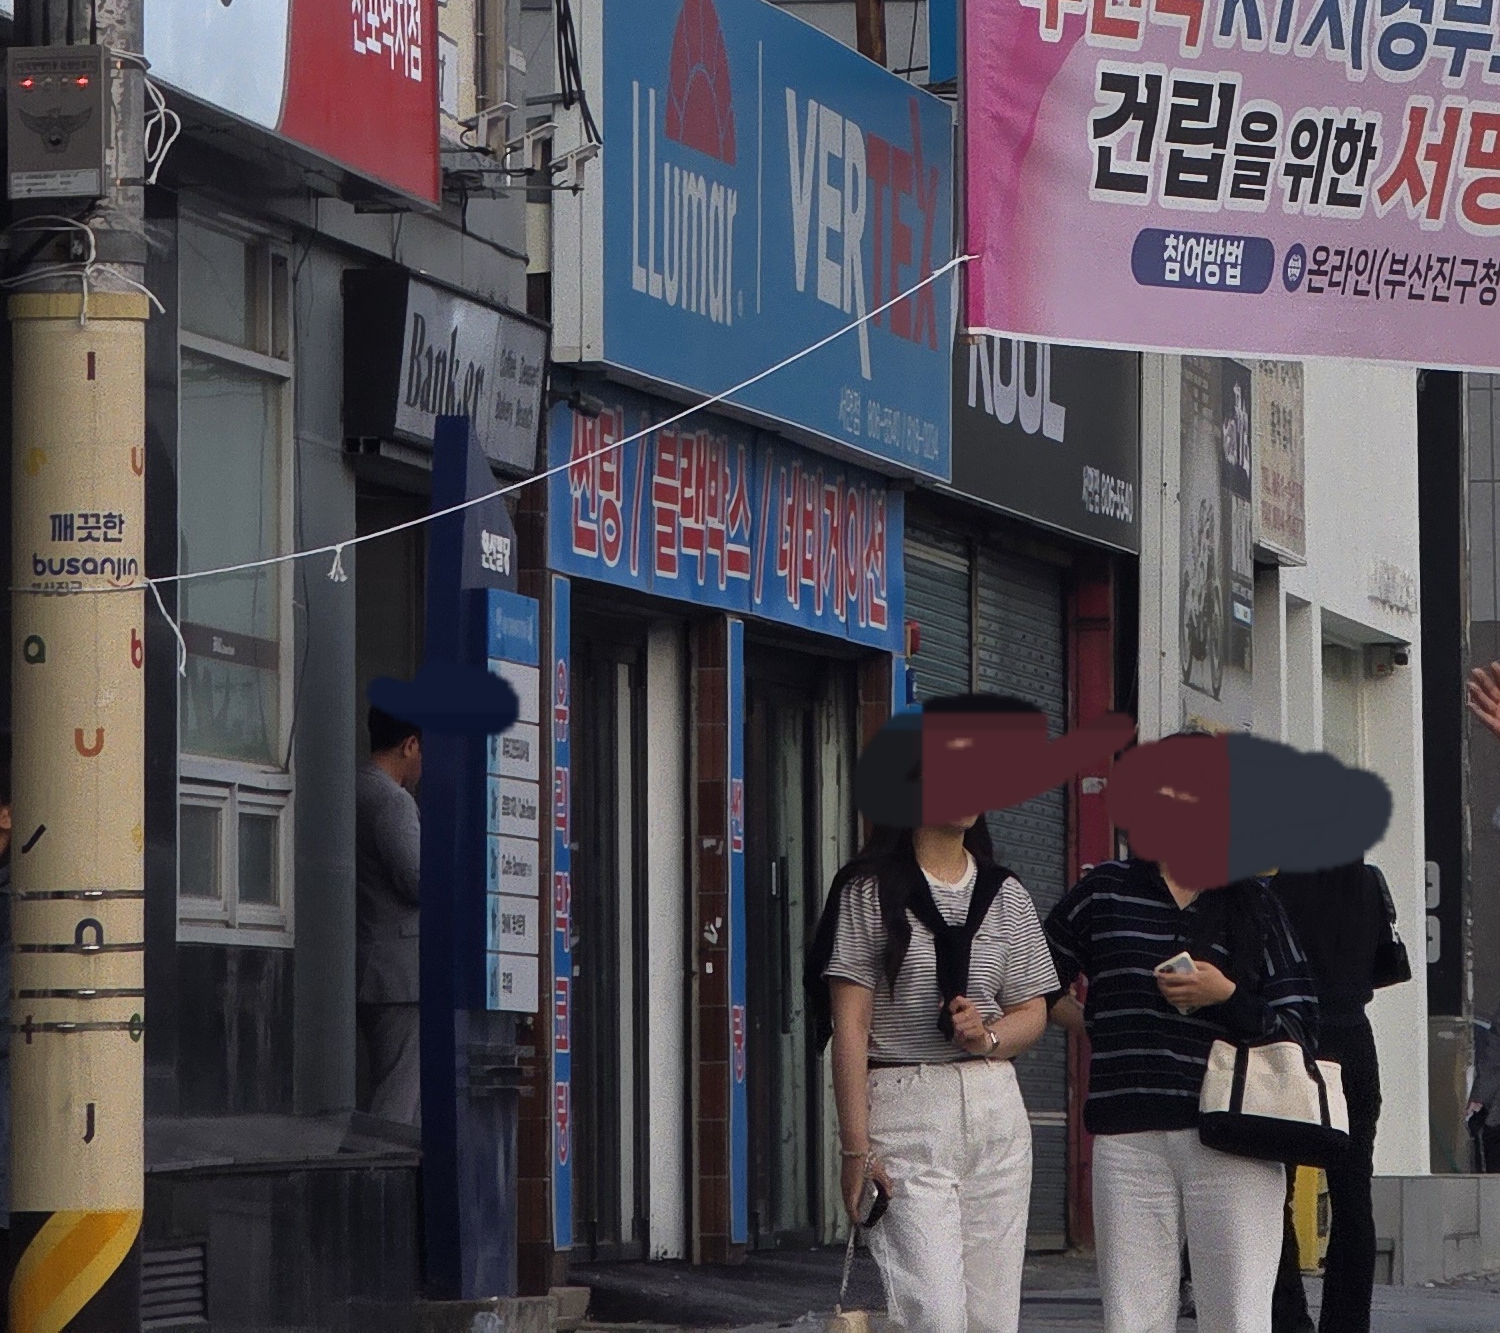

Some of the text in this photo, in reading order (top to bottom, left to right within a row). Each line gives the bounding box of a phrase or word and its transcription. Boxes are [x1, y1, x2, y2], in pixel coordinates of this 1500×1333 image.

[784, 85, 941, 381] VERTEX
[1162, 233, 1246, 288] 참여방법
[567, 405, 625, 568] 썬팅
[50, 511, 125, 543] 깨끗한
[32, 552, 139, 582] busanjin
